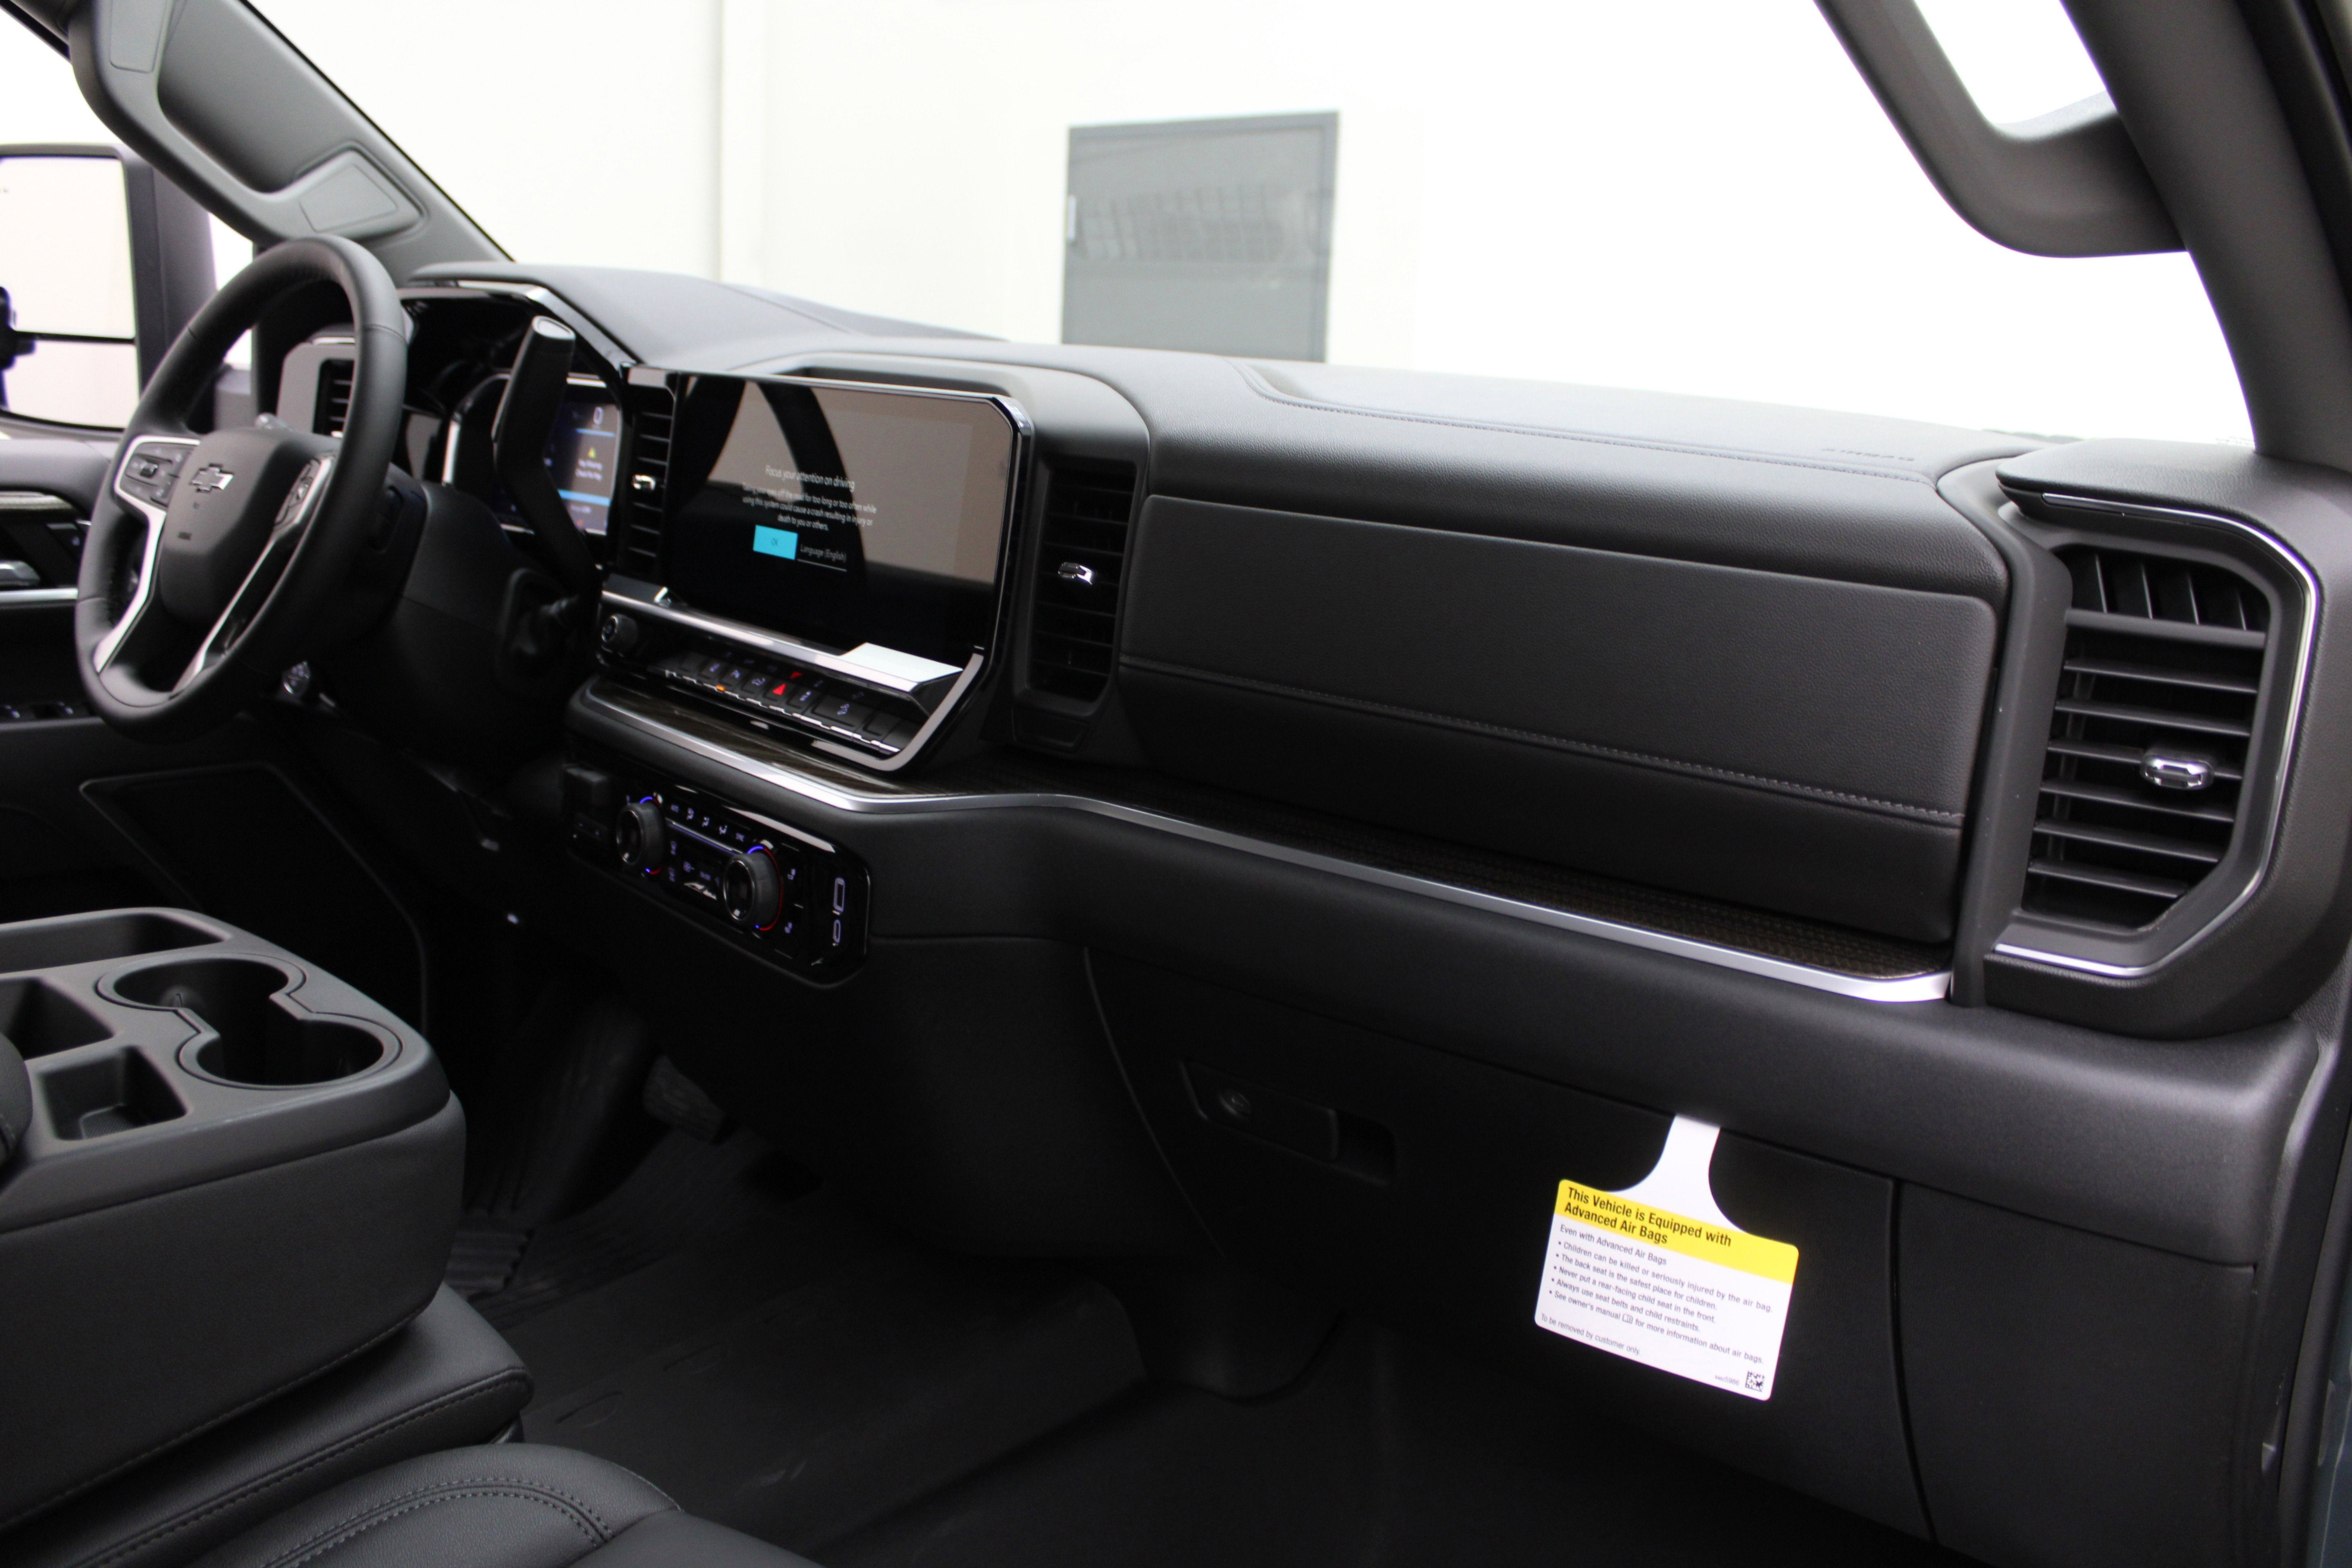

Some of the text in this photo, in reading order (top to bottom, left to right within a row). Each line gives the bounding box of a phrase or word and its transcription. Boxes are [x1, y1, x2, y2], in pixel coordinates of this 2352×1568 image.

[766, 464, 855, 493] Focus your attention on driving
[822, 496, 832, 508] long
[840, 501, 848, 509] too
[863, 505, 876, 514] while
[1565, 1202, 1668, 1244] Advanced Air Bags
[1569, 1187, 1731, 1247] This Vehicle is Equipped with
[1560, 1224, 1667, 1265] Even with Advanced Air Bags
[1559, 1266, 1578, 1278] Never
[1579, 1274, 1591, 1283] put
[1598, 1281, 1636, 1299] rear-facing
[1638, 1294, 1655, 1305] child
[1657, 1300, 1673, 1310] seat
[1674, 1304, 1681, 1312] in
[1683, 1307, 1695, 1316] the
[1697, 1311, 1716, 1324] front.
[1562, 1254, 1573, 1264] The
[1575, 1258, 1590, 1270] back
[1592, 1266, 1607, 1276] seat
[1617, 1273, 1628, 1282] the
[1629, 1278, 1651, 1290] safest
[1653, 1285, 1672, 1296] place
[1674, 1290, 1684, 1299] for
[1686, 1295, 1717, 1311] children.
[1564, 1242, 1592, 1257] Children
[1594, 1254, 1607, 1262] can
[1609, 1257, 1617, 1265] be
[1620, 1261, 1640, 1273] killed
[1651, 1272, 1685, 1288] seriously
[1687, 1281, 1714, 1296] injured
[1716, 1290, 1726, 1300] by
[1728, 1294, 1740, 1303] the
[1743, 1298, 1754, 1307] air
[1756, 1301, 1773, 1313] bag.
[1555, 1291, 1764, 1365] See owner's manual for more information about air bags.
[1557, 1278, 1700, 1332] Always use seat belts and child restraints.
[1541, 1313, 1640, 1356] To be removed by customer only.
